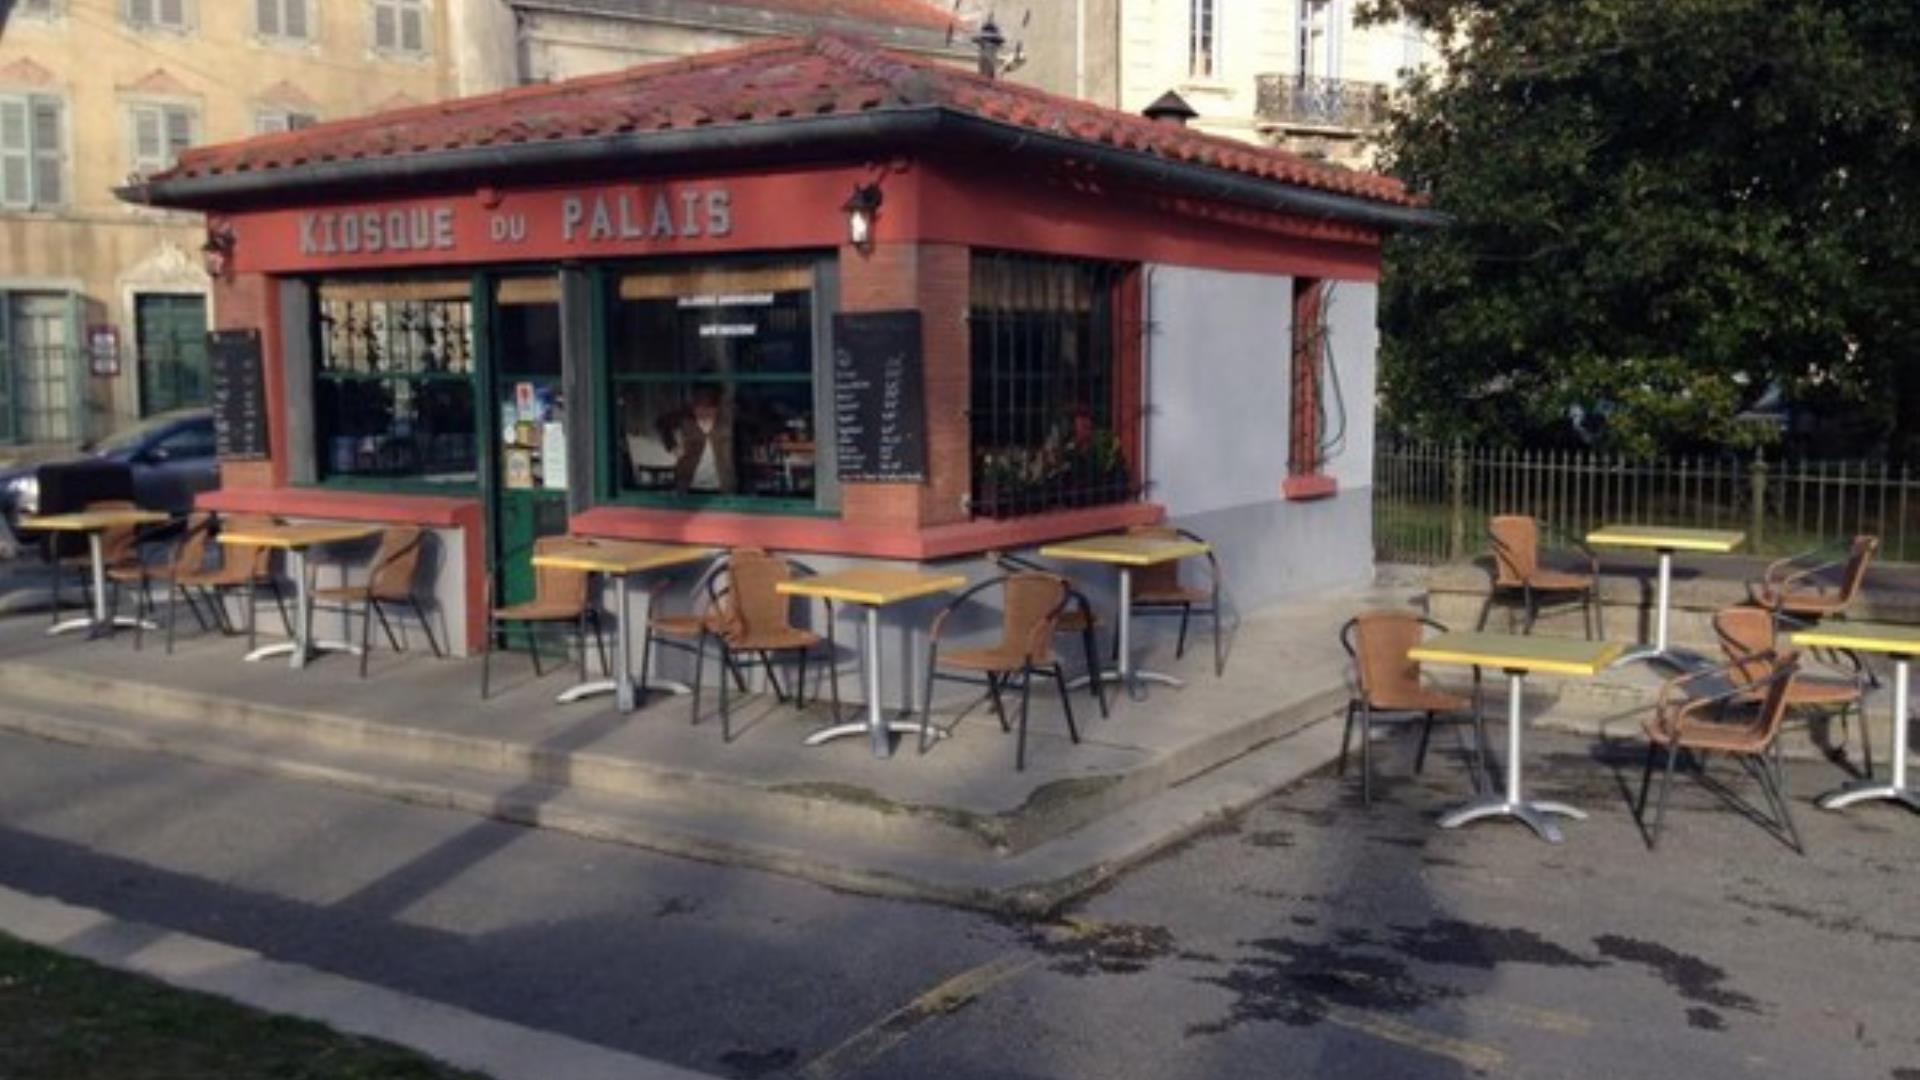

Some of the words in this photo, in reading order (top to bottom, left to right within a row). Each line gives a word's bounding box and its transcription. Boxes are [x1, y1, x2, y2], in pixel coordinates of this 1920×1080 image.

[300, 207, 454, 255] KIOSQUE
[490, 215, 526, 241] DU
[563, 189, 732, 240] PALAIS
